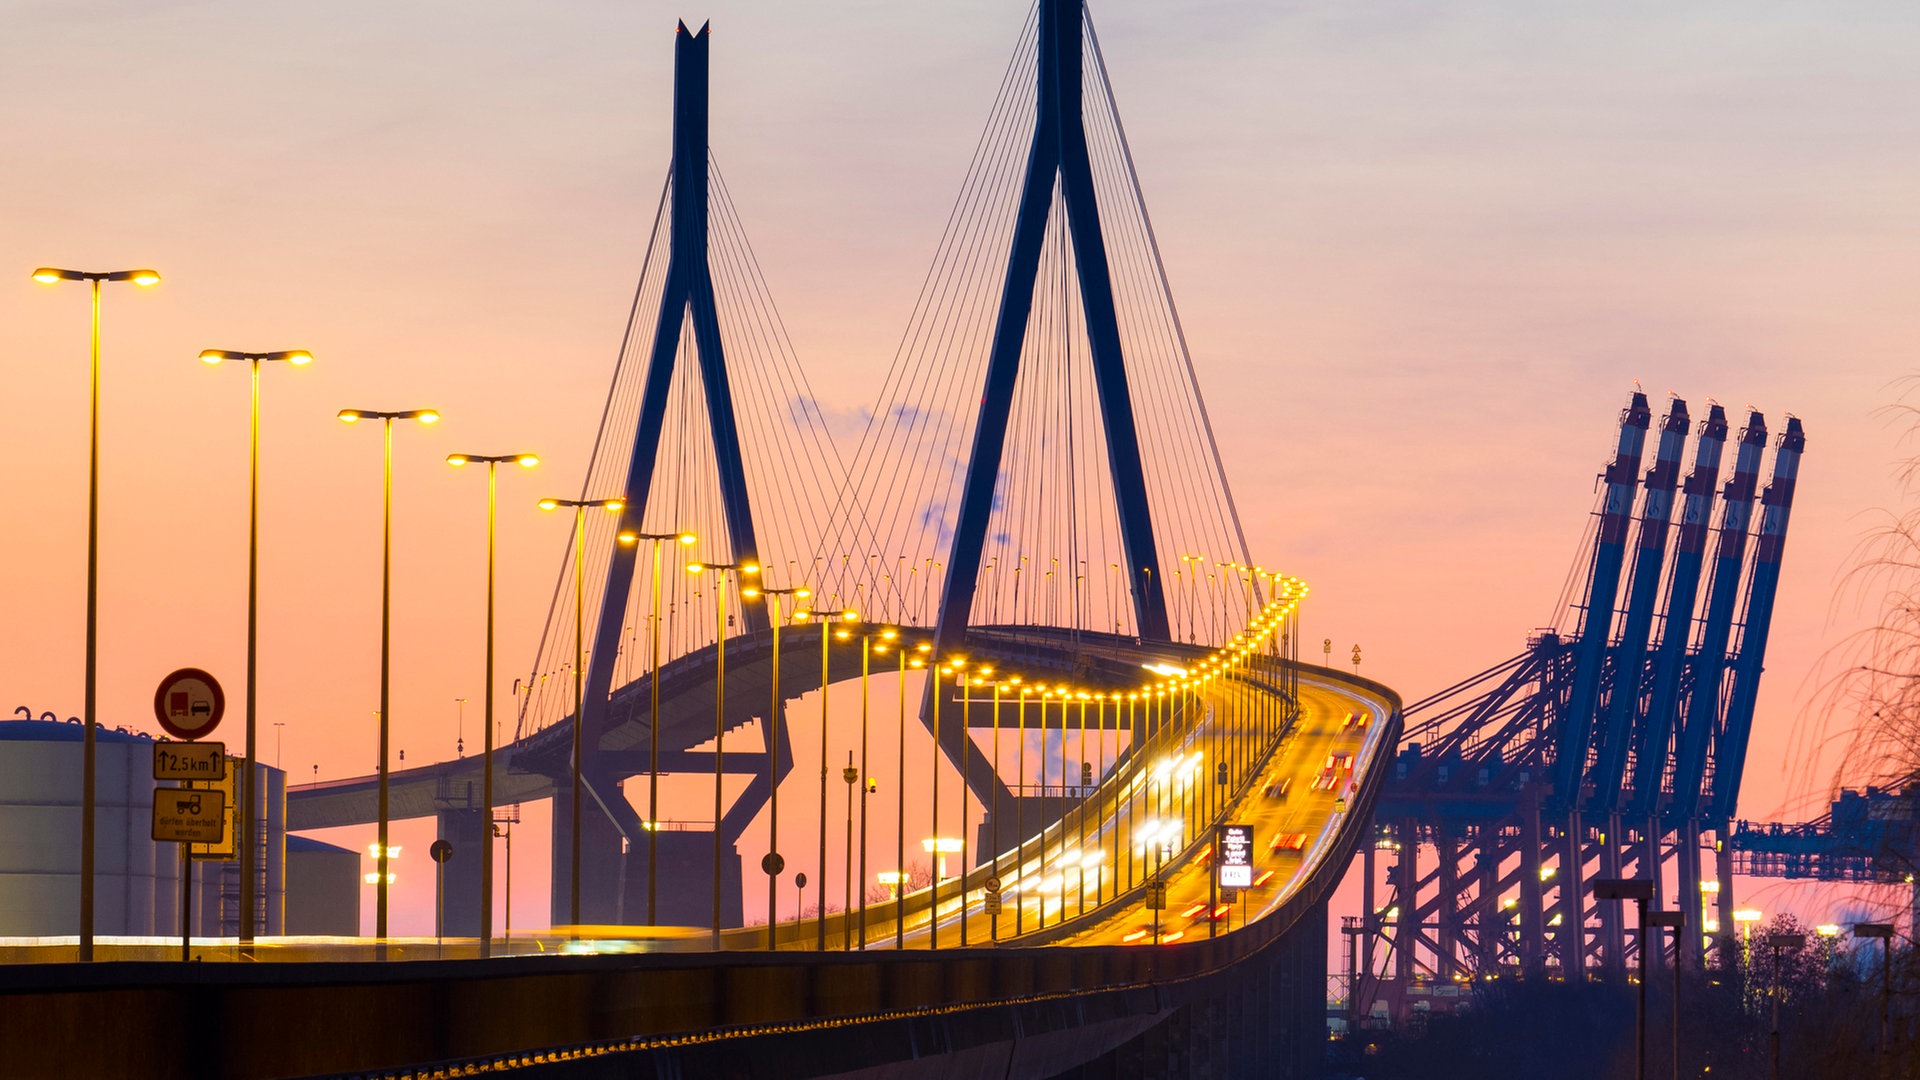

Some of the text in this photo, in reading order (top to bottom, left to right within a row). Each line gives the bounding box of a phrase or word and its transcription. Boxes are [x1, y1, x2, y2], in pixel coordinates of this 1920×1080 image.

[170, 755, 208, 772] 2,5 km
[175, 828, 200, 837] werden
